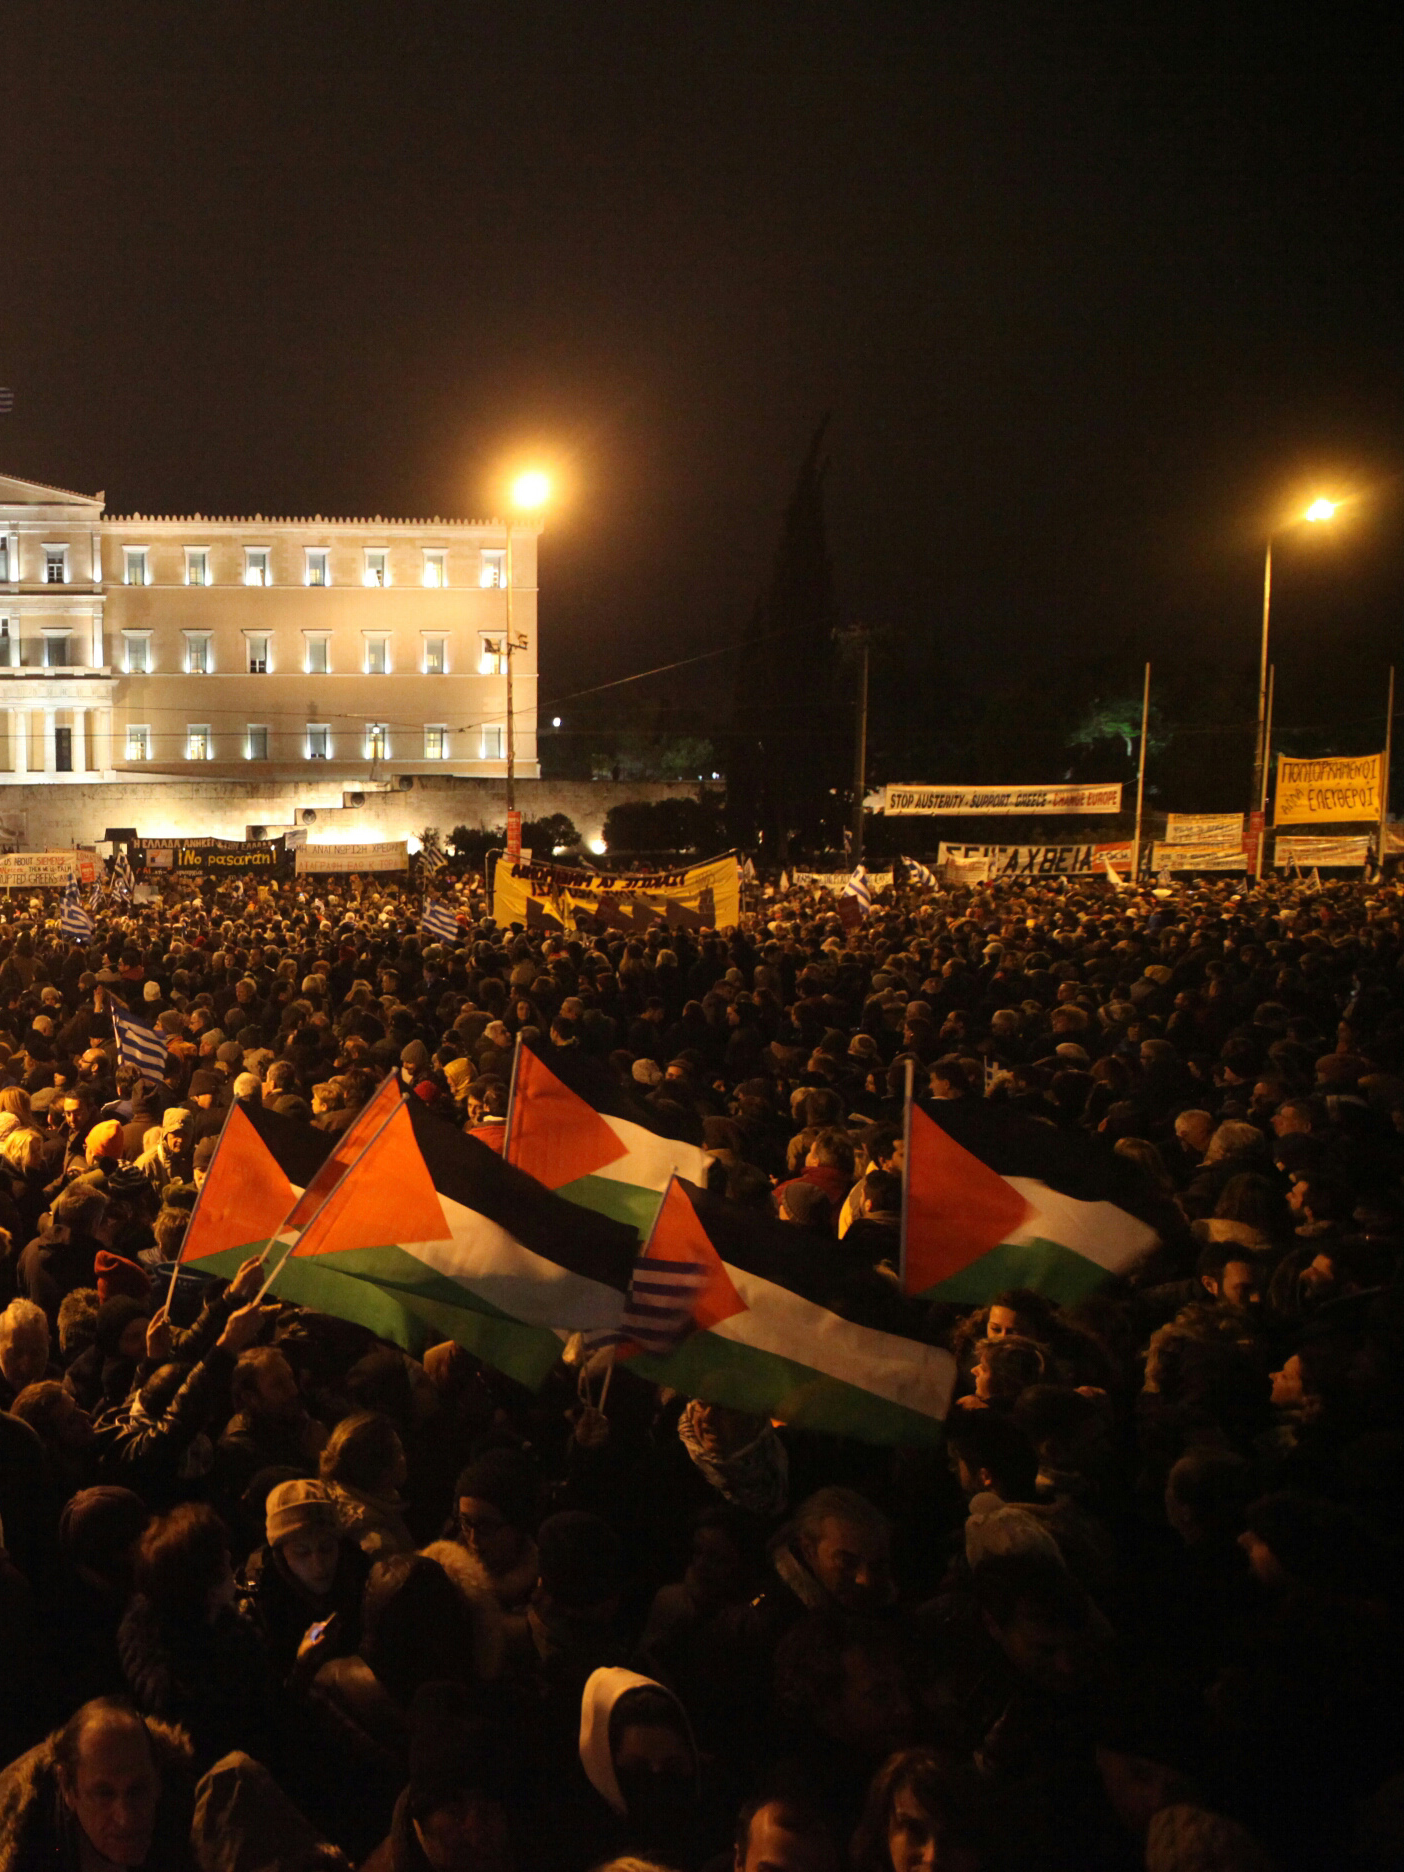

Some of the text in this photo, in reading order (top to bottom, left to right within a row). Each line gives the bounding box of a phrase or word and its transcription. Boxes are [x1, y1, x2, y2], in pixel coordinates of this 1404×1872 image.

[890, 790, 1118, 808] STOP AUSTERITY SUPPORT GREECE CHANGE EUROPE
[143, 839, 180, 849] ΕΛΛΑΔΑ
[183, 838, 215, 848] ΑΝΗΚΕΙ
[4, 857, 12, 866] US
[14, 857, 33, 866] ABOUT
[28, 873, 58, 885] GREEKS
